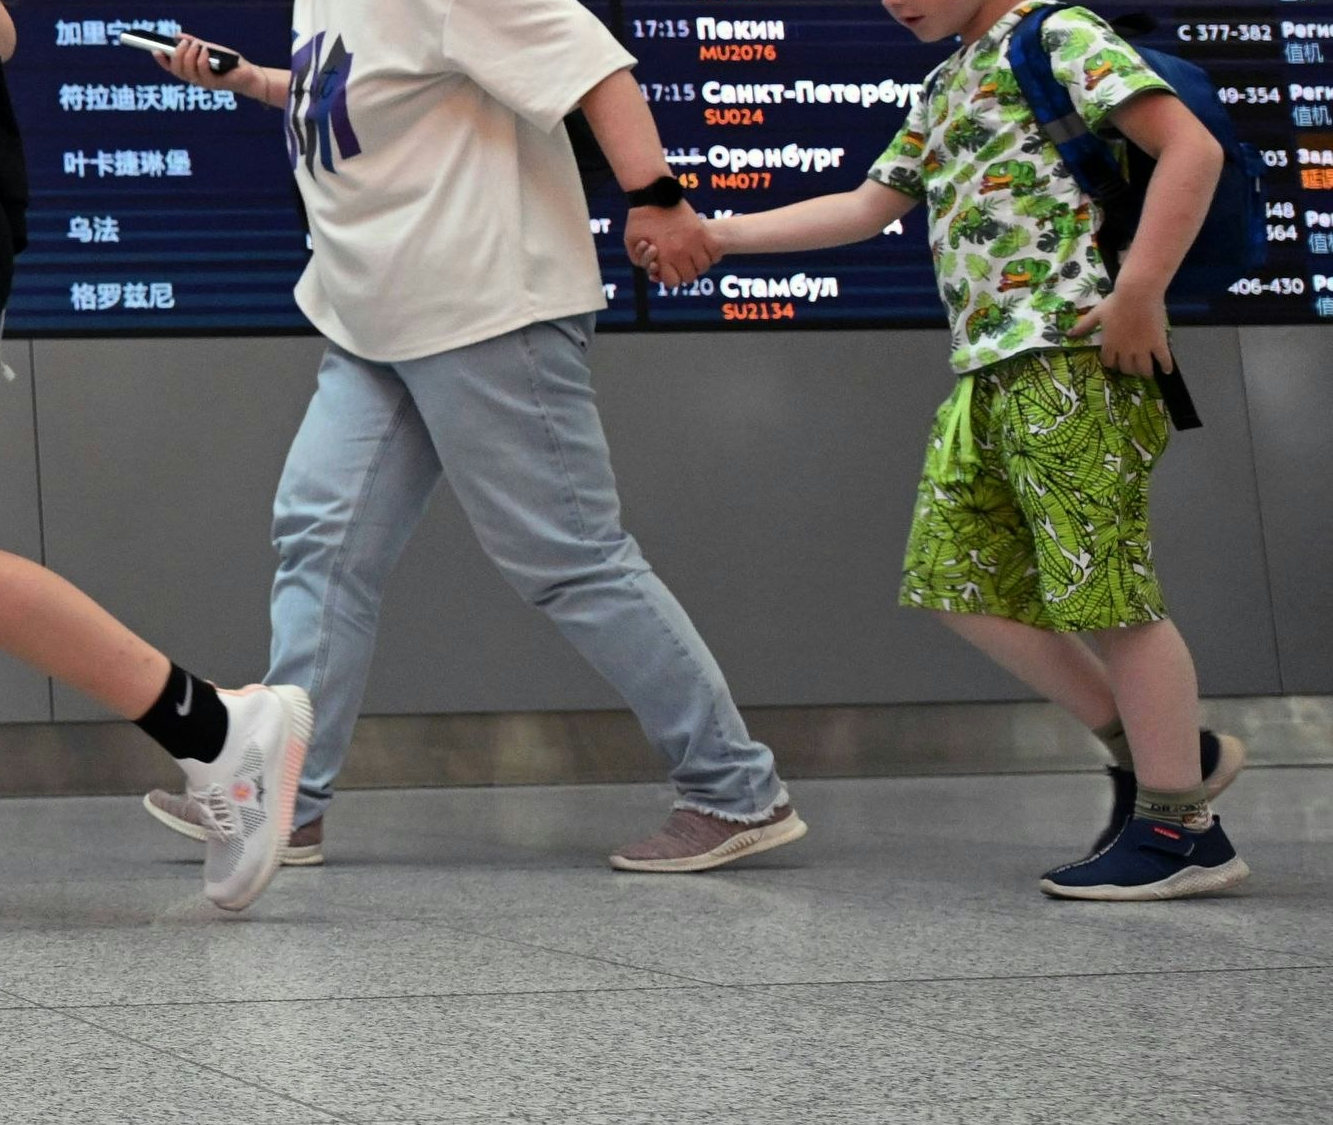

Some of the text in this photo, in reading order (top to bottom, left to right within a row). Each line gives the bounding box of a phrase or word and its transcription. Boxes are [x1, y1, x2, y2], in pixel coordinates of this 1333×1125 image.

[634, 17, 784, 40] 17:15 Пекин
[1178, 25, 1191, 41] C
[700, 45, 776, 60] MU2076
[705, 109, 763, 124] SU024
[708, 144, 844, 173] Оренбург
[711, 173, 771, 188] N4077
[67, 216, 119, 242] 乌法
[720, 273, 838, 300] Стамбул
[722, 303, 794, 320] SU2134
